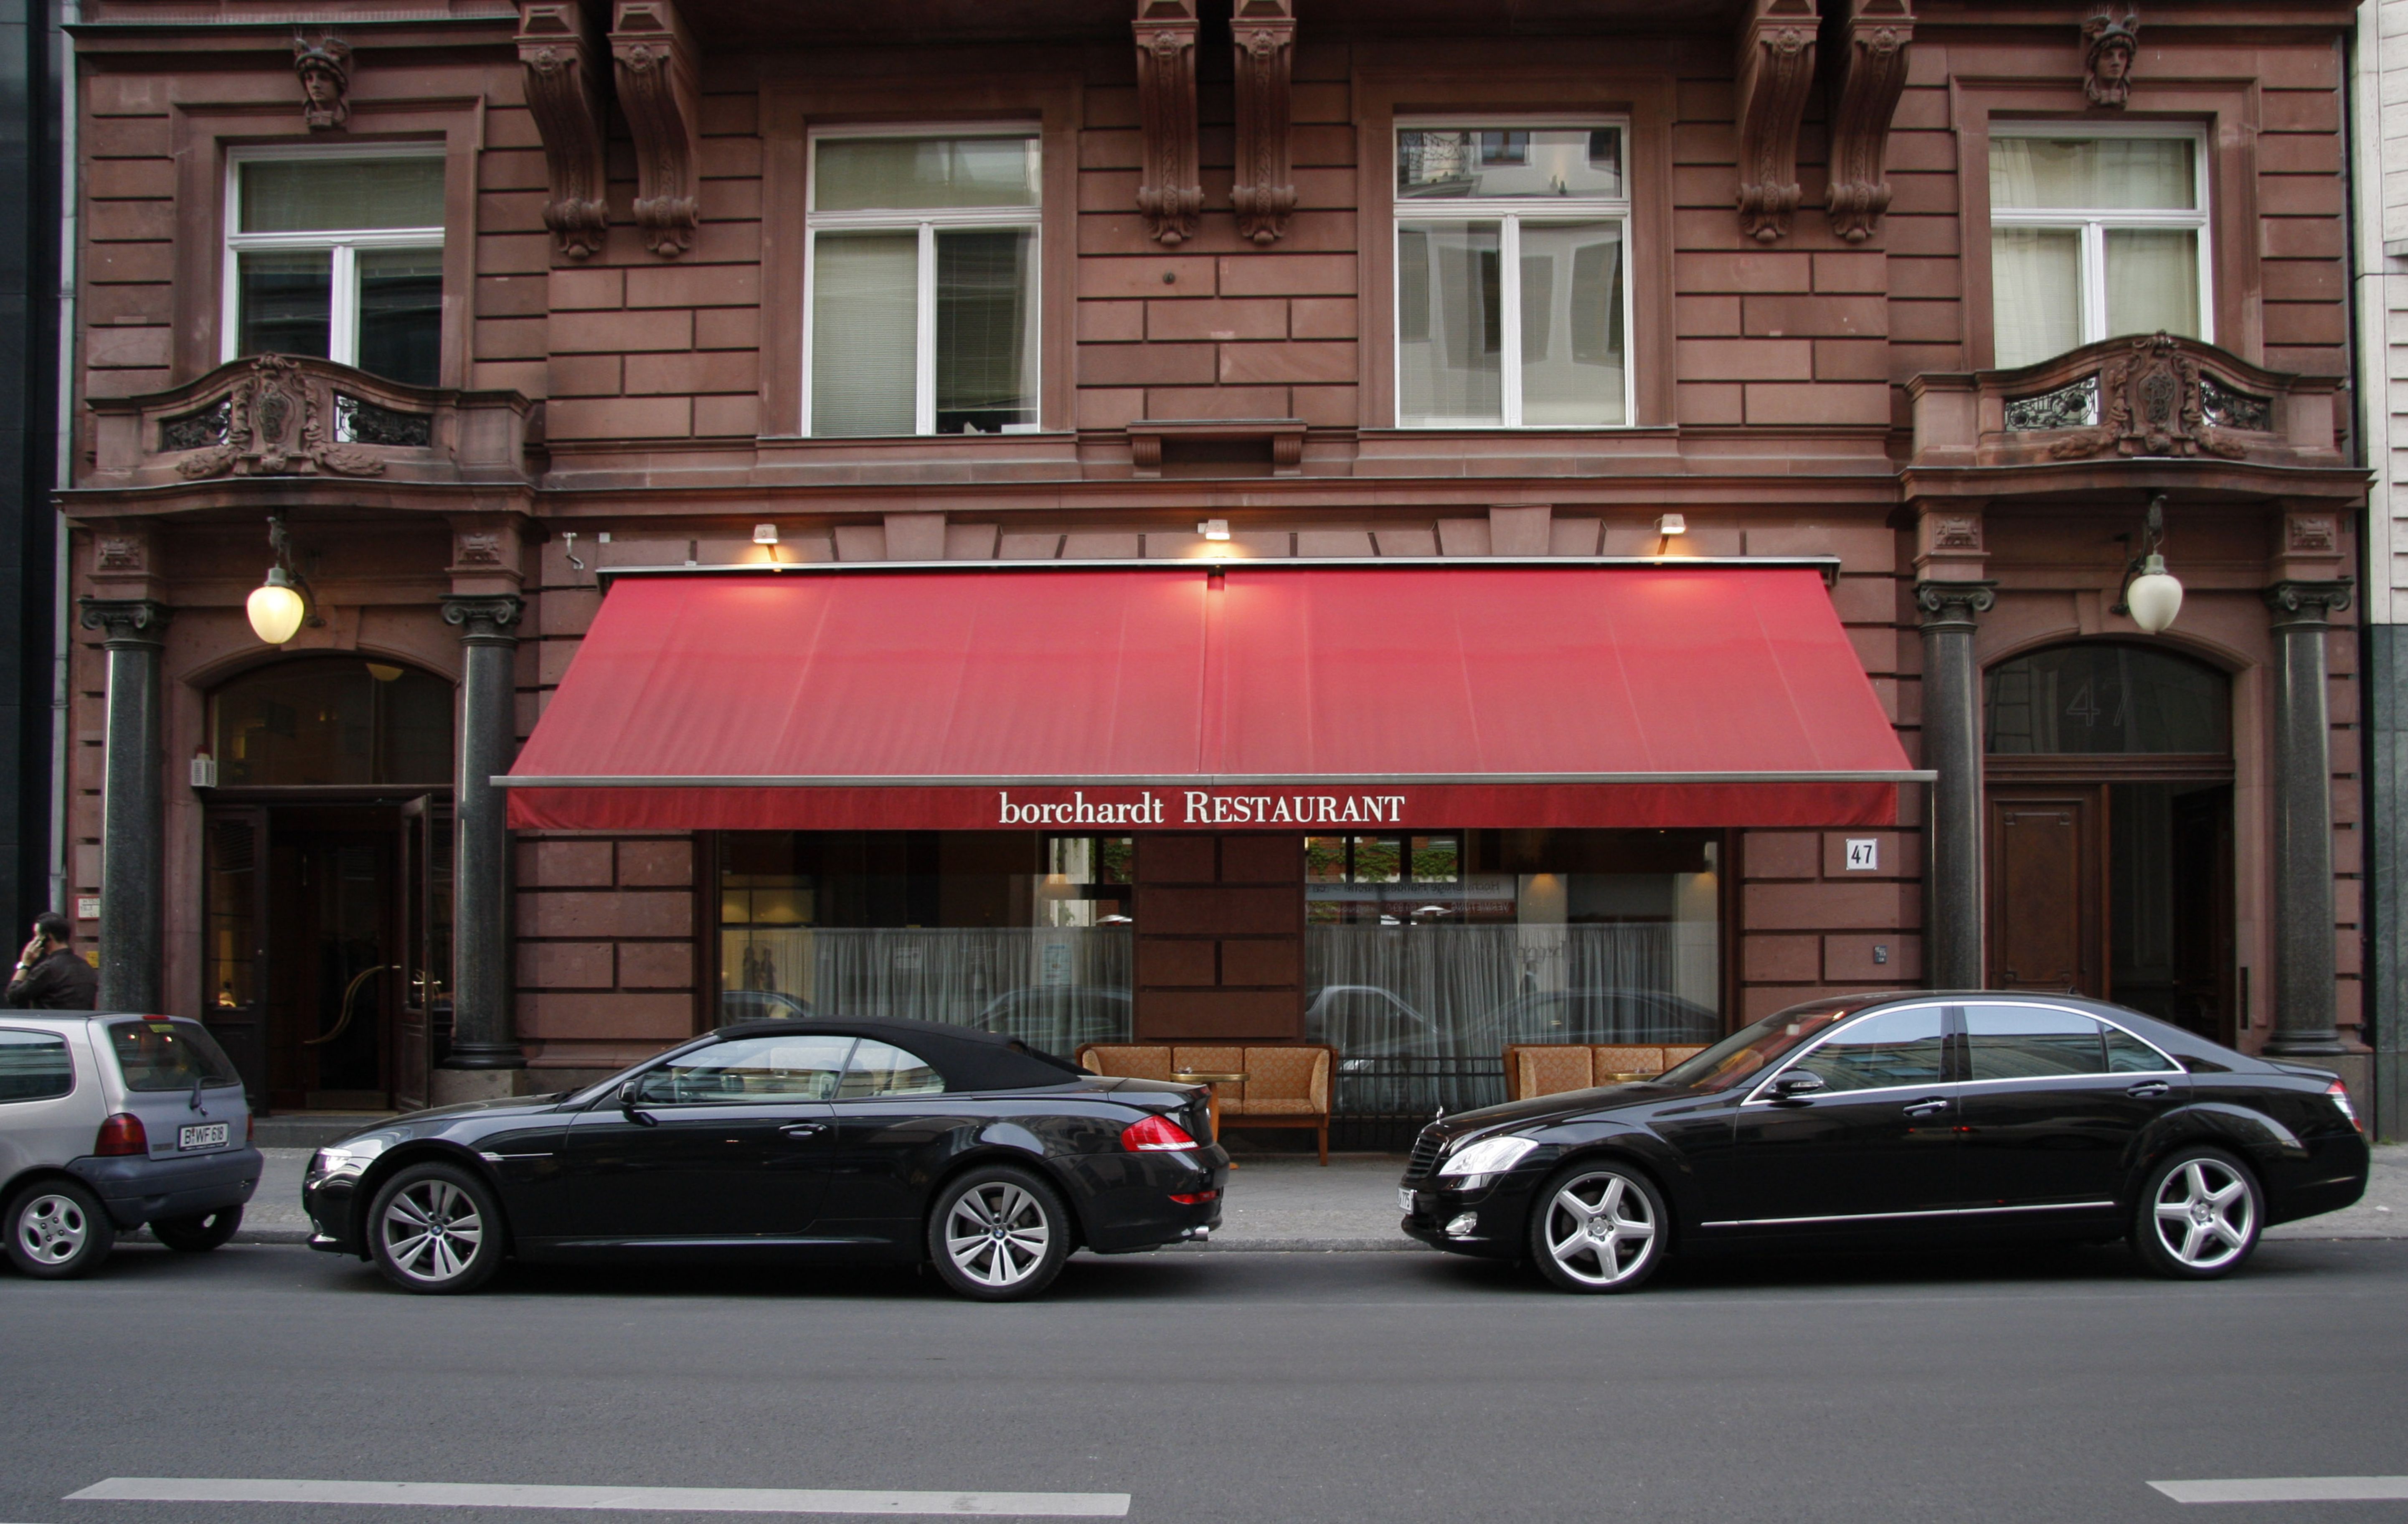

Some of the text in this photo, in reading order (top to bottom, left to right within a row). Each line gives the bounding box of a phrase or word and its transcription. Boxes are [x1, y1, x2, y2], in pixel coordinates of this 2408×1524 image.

[2067, 678, 2129, 726] 47
[999, 792, 1405, 823] borchardt RESTAURANT
[1851, 845, 1872, 864] 47
[185, 1130, 191, 1144] B
[196, 1128, 211, 1143] WF
